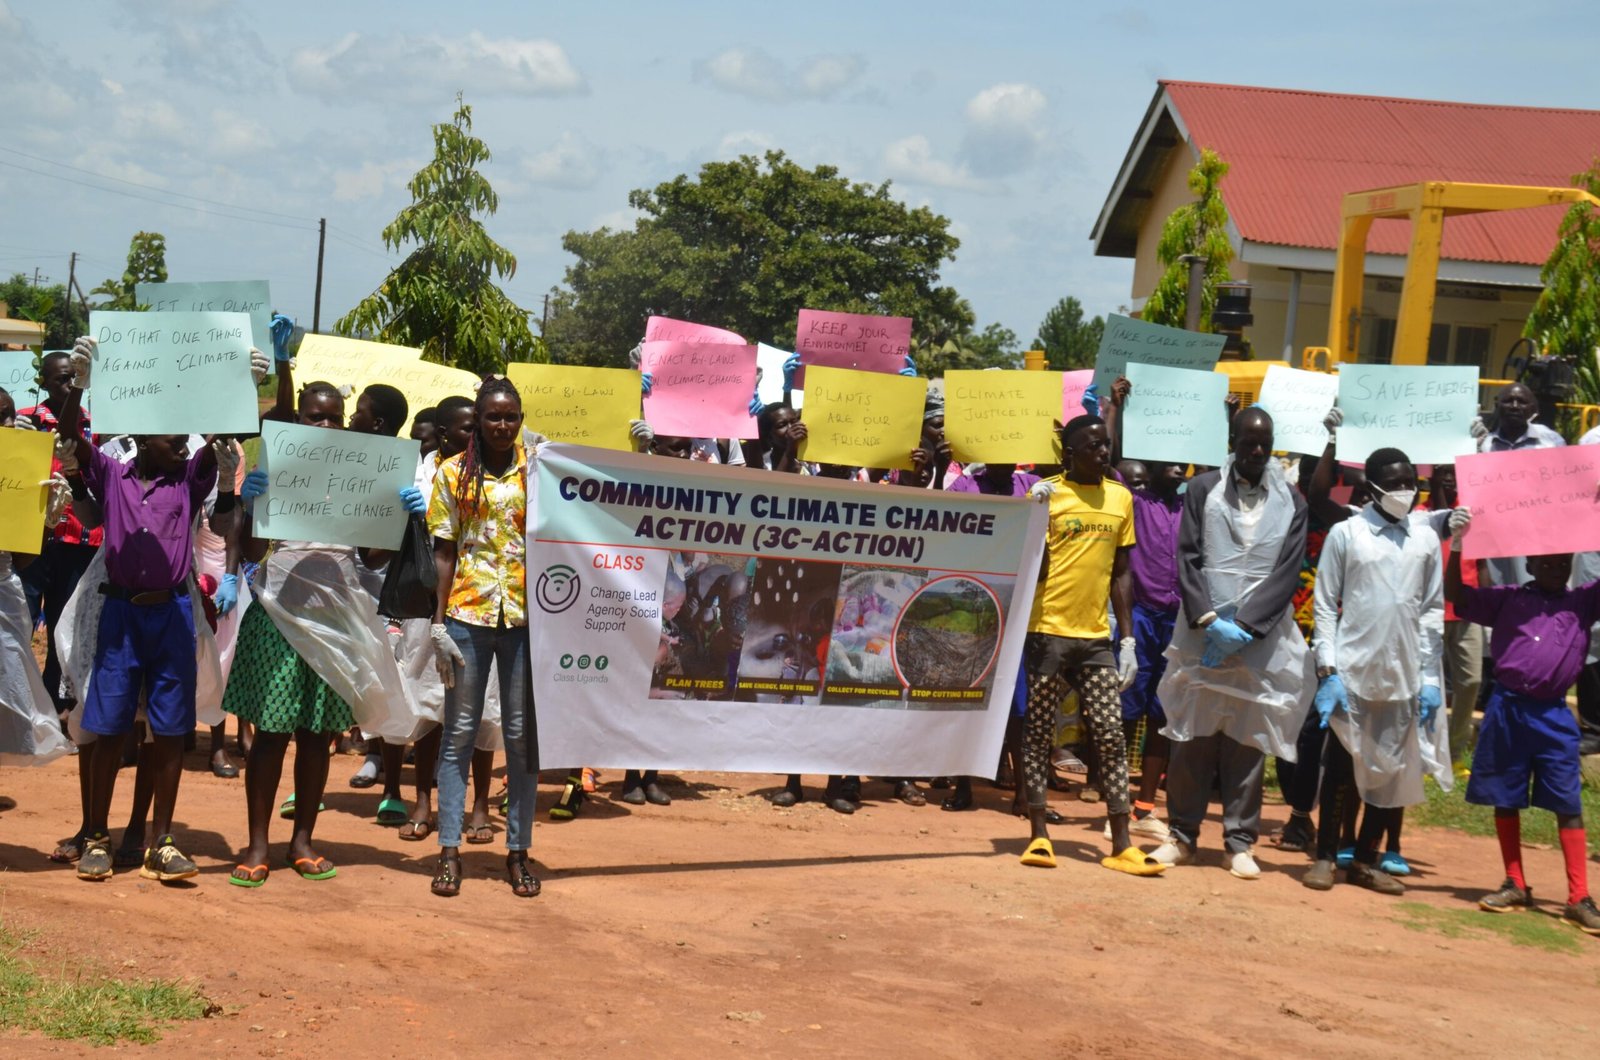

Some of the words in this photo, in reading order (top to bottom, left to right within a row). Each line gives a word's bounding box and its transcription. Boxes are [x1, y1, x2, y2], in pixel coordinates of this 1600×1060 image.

[98, 326, 121, 344] DO
[127, 326, 161, 344] THAT
[172, 331, 200, 344] ONE
[206, 327, 243, 343] THING
[810, 319, 849, 336] KEEP
[858, 327, 890, 340] YOUR
[1112, 322, 1141, 342] TAKE
[102, 358, 158, 373] AGAINST
[178, 351, 239, 372] CLIMATE
[648, 352, 686, 366] ENACT
[668, 374, 704, 386] CLIMATE
[1351, 374, 1416, 400] SAVE
[1425, 381, 1474, 398] ENERGY
[110, 385, 162, 401] CHANGE
[815, 386, 872, 406] PLANTS
[956, 387, 1024, 399] CLIMATE
[535, 408, 588, 418] CLIMATE
[827, 412, 853, 424] ARE
[863, 416, 891, 426] OUR
[962, 408, 1017, 421] JUSTICE
[1021, 408, 1029, 416] IS
[1352, 412, 1399, 429] SAVE
[1407, 411, 1453, 427] TREES
[274, 430, 367, 466] TOGETHER
[377, 455, 400, 473] WE
[276, 470, 311, 488] CAN
[327, 476, 377, 494] FIGHT
[266, 497, 333, 517] CLIMATE
[342, 504, 395, 518] CHANGE
[560, 476, 742, 515] COMMUNITY
[750, 494, 877, 527] CLIMATE
[886, 506, 996, 536] CHANGE
[1496, 496, 1552, 513] CLIMATE
[635, 515, 746, 545] ACTION
[752, 523, 925, 563] (3C-ACTION)
[592, 553, 645, 571] CLASS
[591, 586, 631, 602] Change
[634, 589, 657, 601] Lead
[587, 603, 627, 619] Agency
[630, 606, 659, 618] Social
[584, 618, 626, 633] Support
[553, 673, 575, 682] Class
[576, 673, 608, 684] Uganda
[665, 678, 692, 688] PLAN
[694, 680, 724, 689] TREES
[911, 689, 931, 697] STOP
[932, 690, 961, 698] CUTTING
[963, 690, 984, 698] TREES
